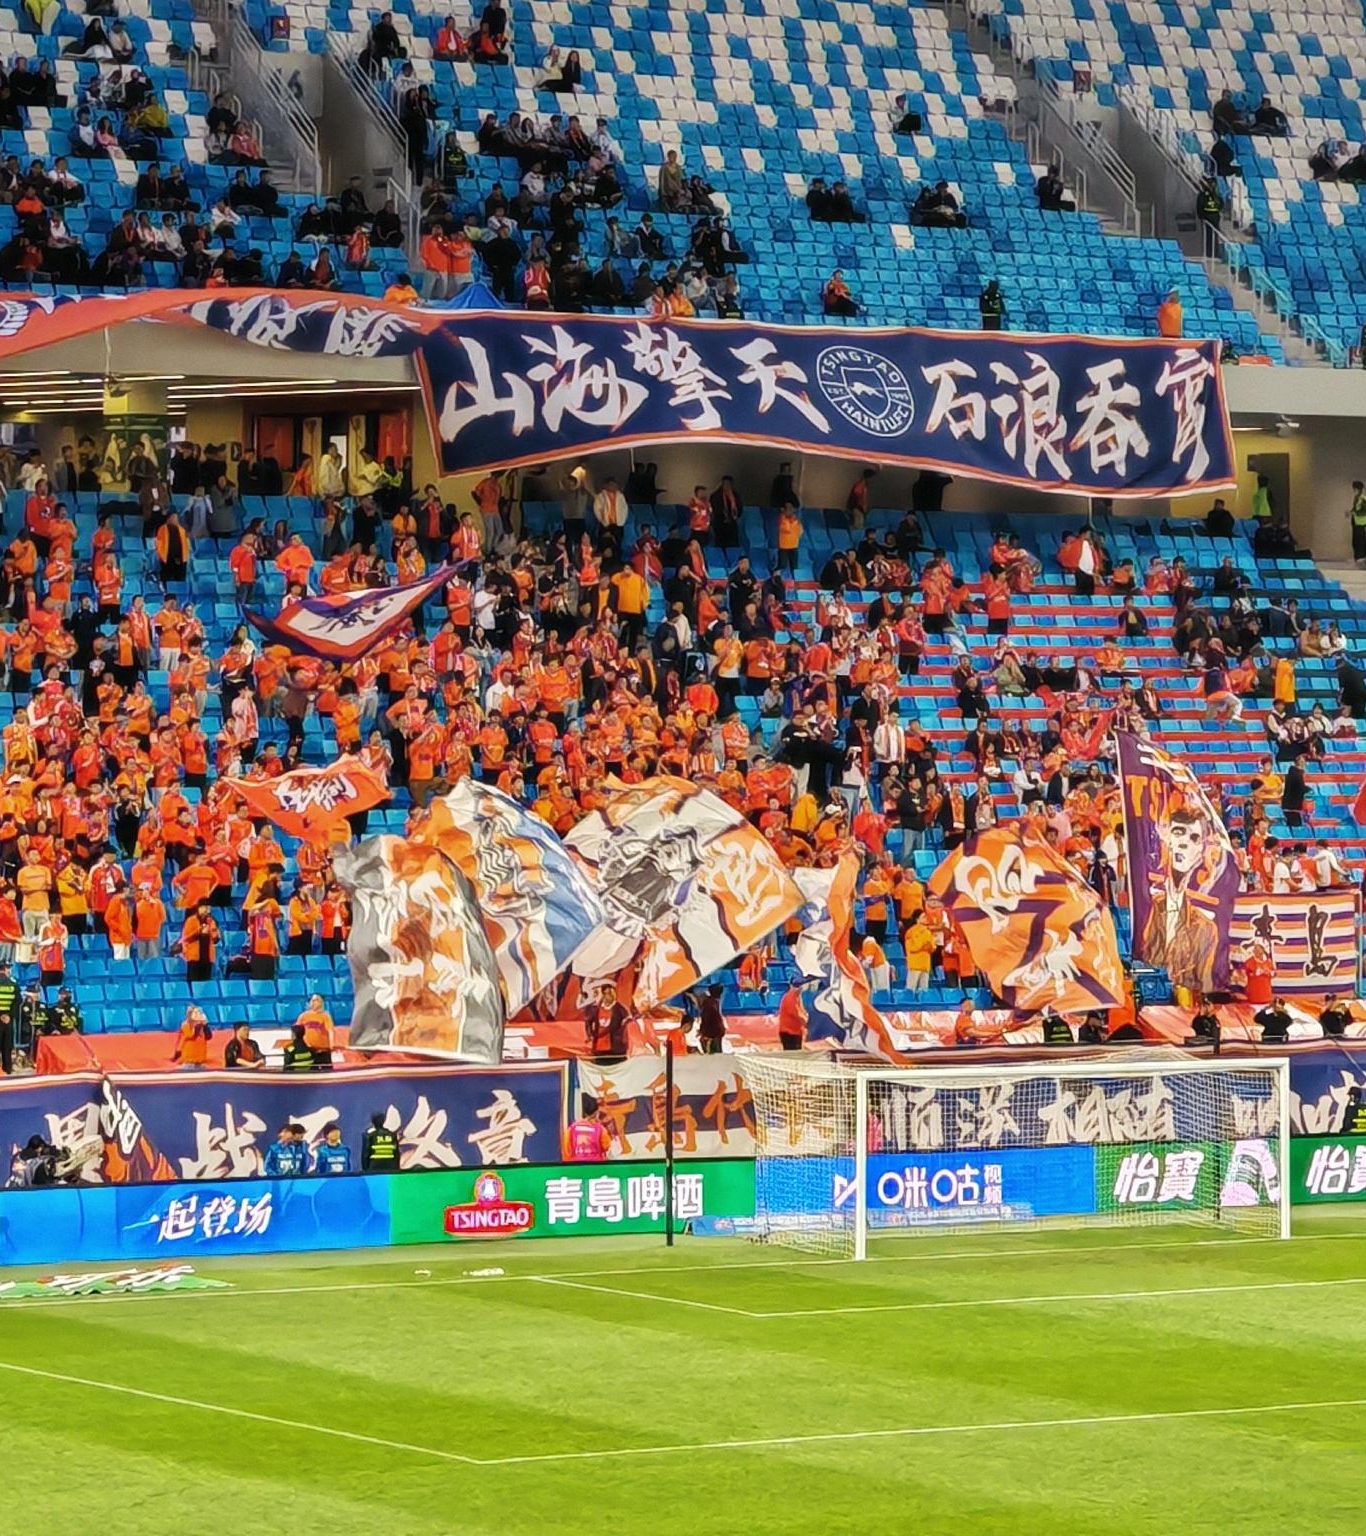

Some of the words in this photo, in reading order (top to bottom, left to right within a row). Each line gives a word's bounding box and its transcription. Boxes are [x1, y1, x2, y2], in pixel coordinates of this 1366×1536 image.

[440, 323, 832, 441] 山海擎天
[122, 1192, 273, 1244] 一起登场
[450, 1208, 530, 1228] TSINGTAO
